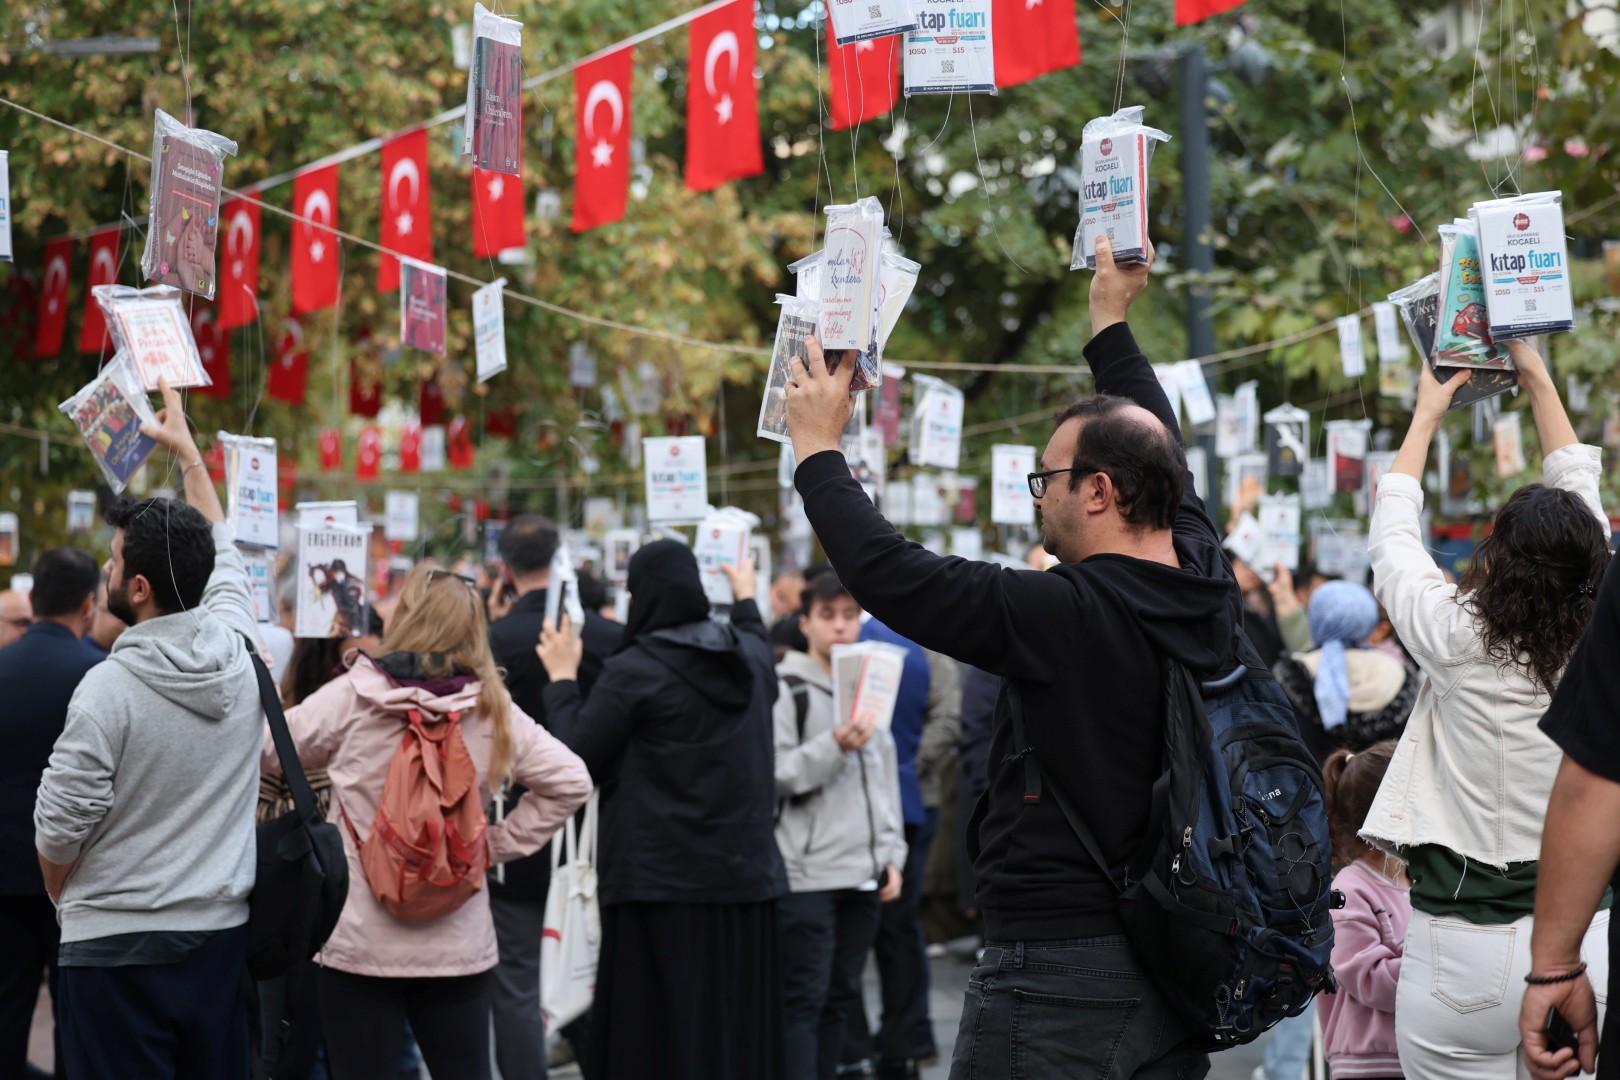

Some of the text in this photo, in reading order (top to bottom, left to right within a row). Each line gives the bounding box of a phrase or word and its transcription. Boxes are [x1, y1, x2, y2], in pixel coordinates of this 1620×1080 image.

[948, 8, 986, 28] fuarı
[1109, 175, 1134, 195] fuarı
[1507, 237, 1541, 246] KOCAELİ
[828, 249, 851, 268] milan
[1490, 249, 1562, 273] kitap fuarı
[831, 267, 862, 289] kundera
